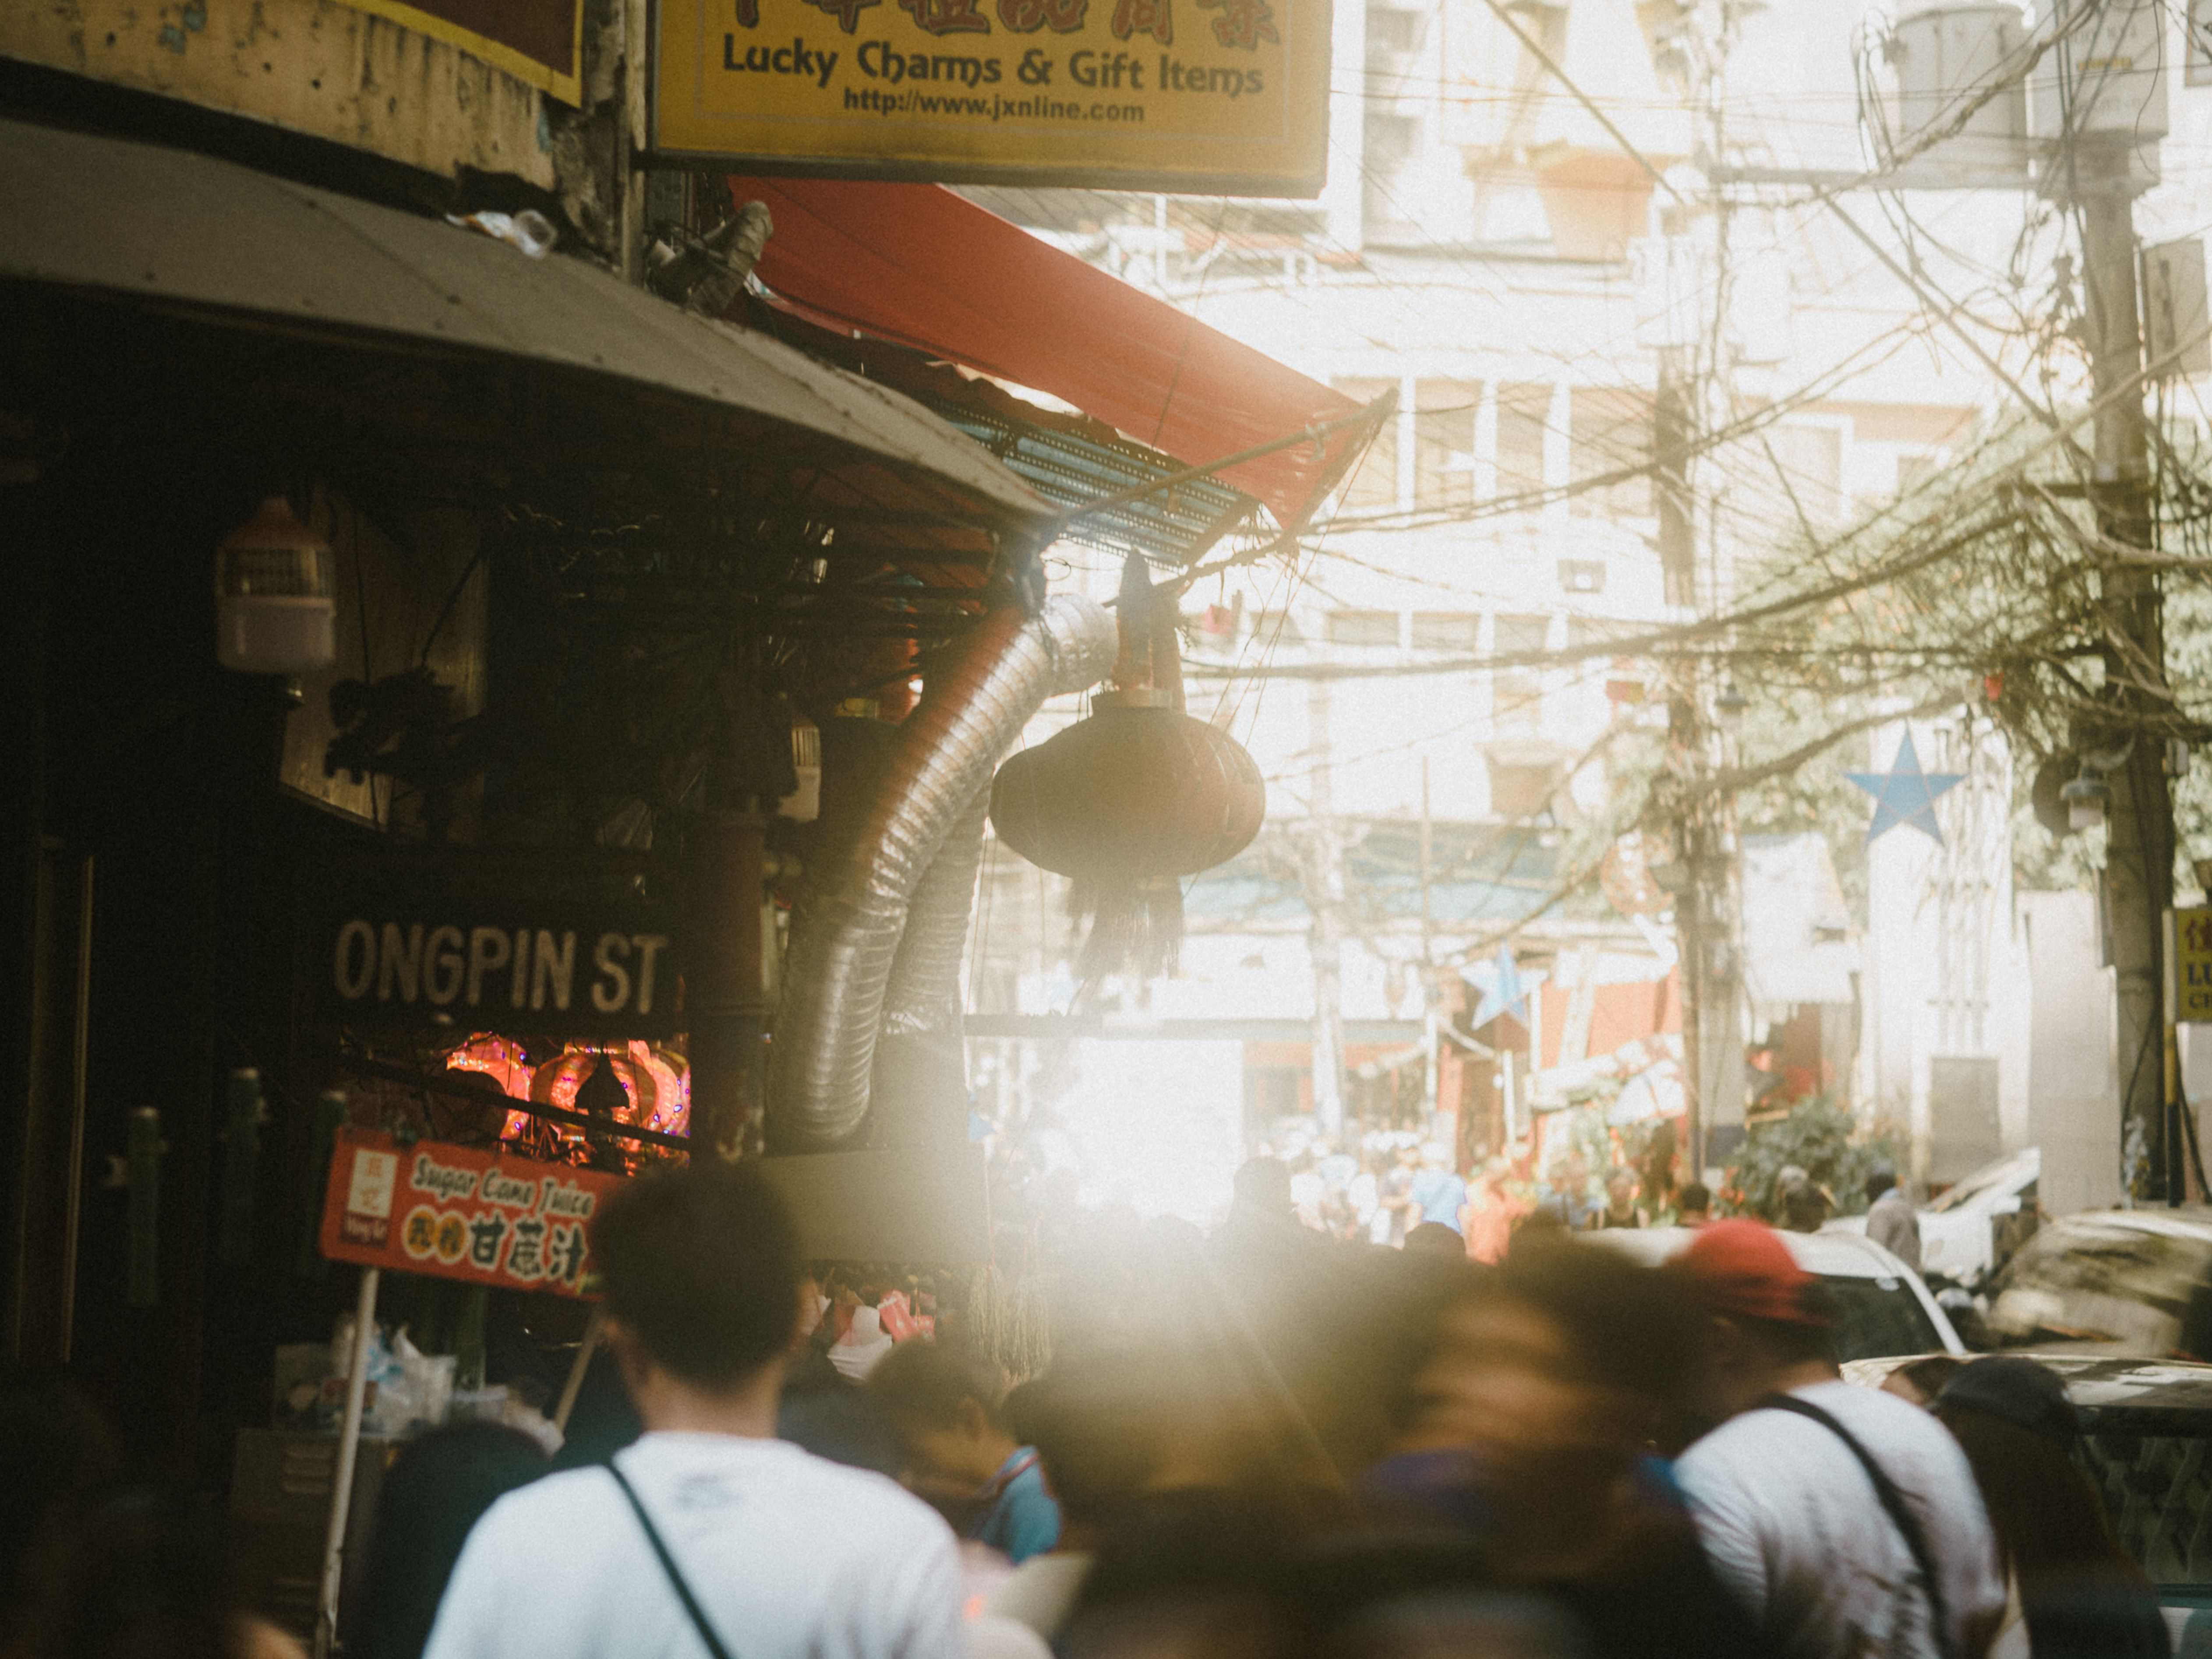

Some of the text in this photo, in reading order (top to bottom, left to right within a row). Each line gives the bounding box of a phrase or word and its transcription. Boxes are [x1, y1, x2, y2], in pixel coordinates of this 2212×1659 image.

[723, 32, 1265, 99] Lucky Charms & Gift Items
[843, 87, 1144, 121] http://www.jxnline.com
[334, 920, 668, 1015] ONGPIN ST
[412, 1154, 477, 1201] Sugar
[481, 1168, 535, 1207] Cane
[537, 1178, 594, 1218] Juice
